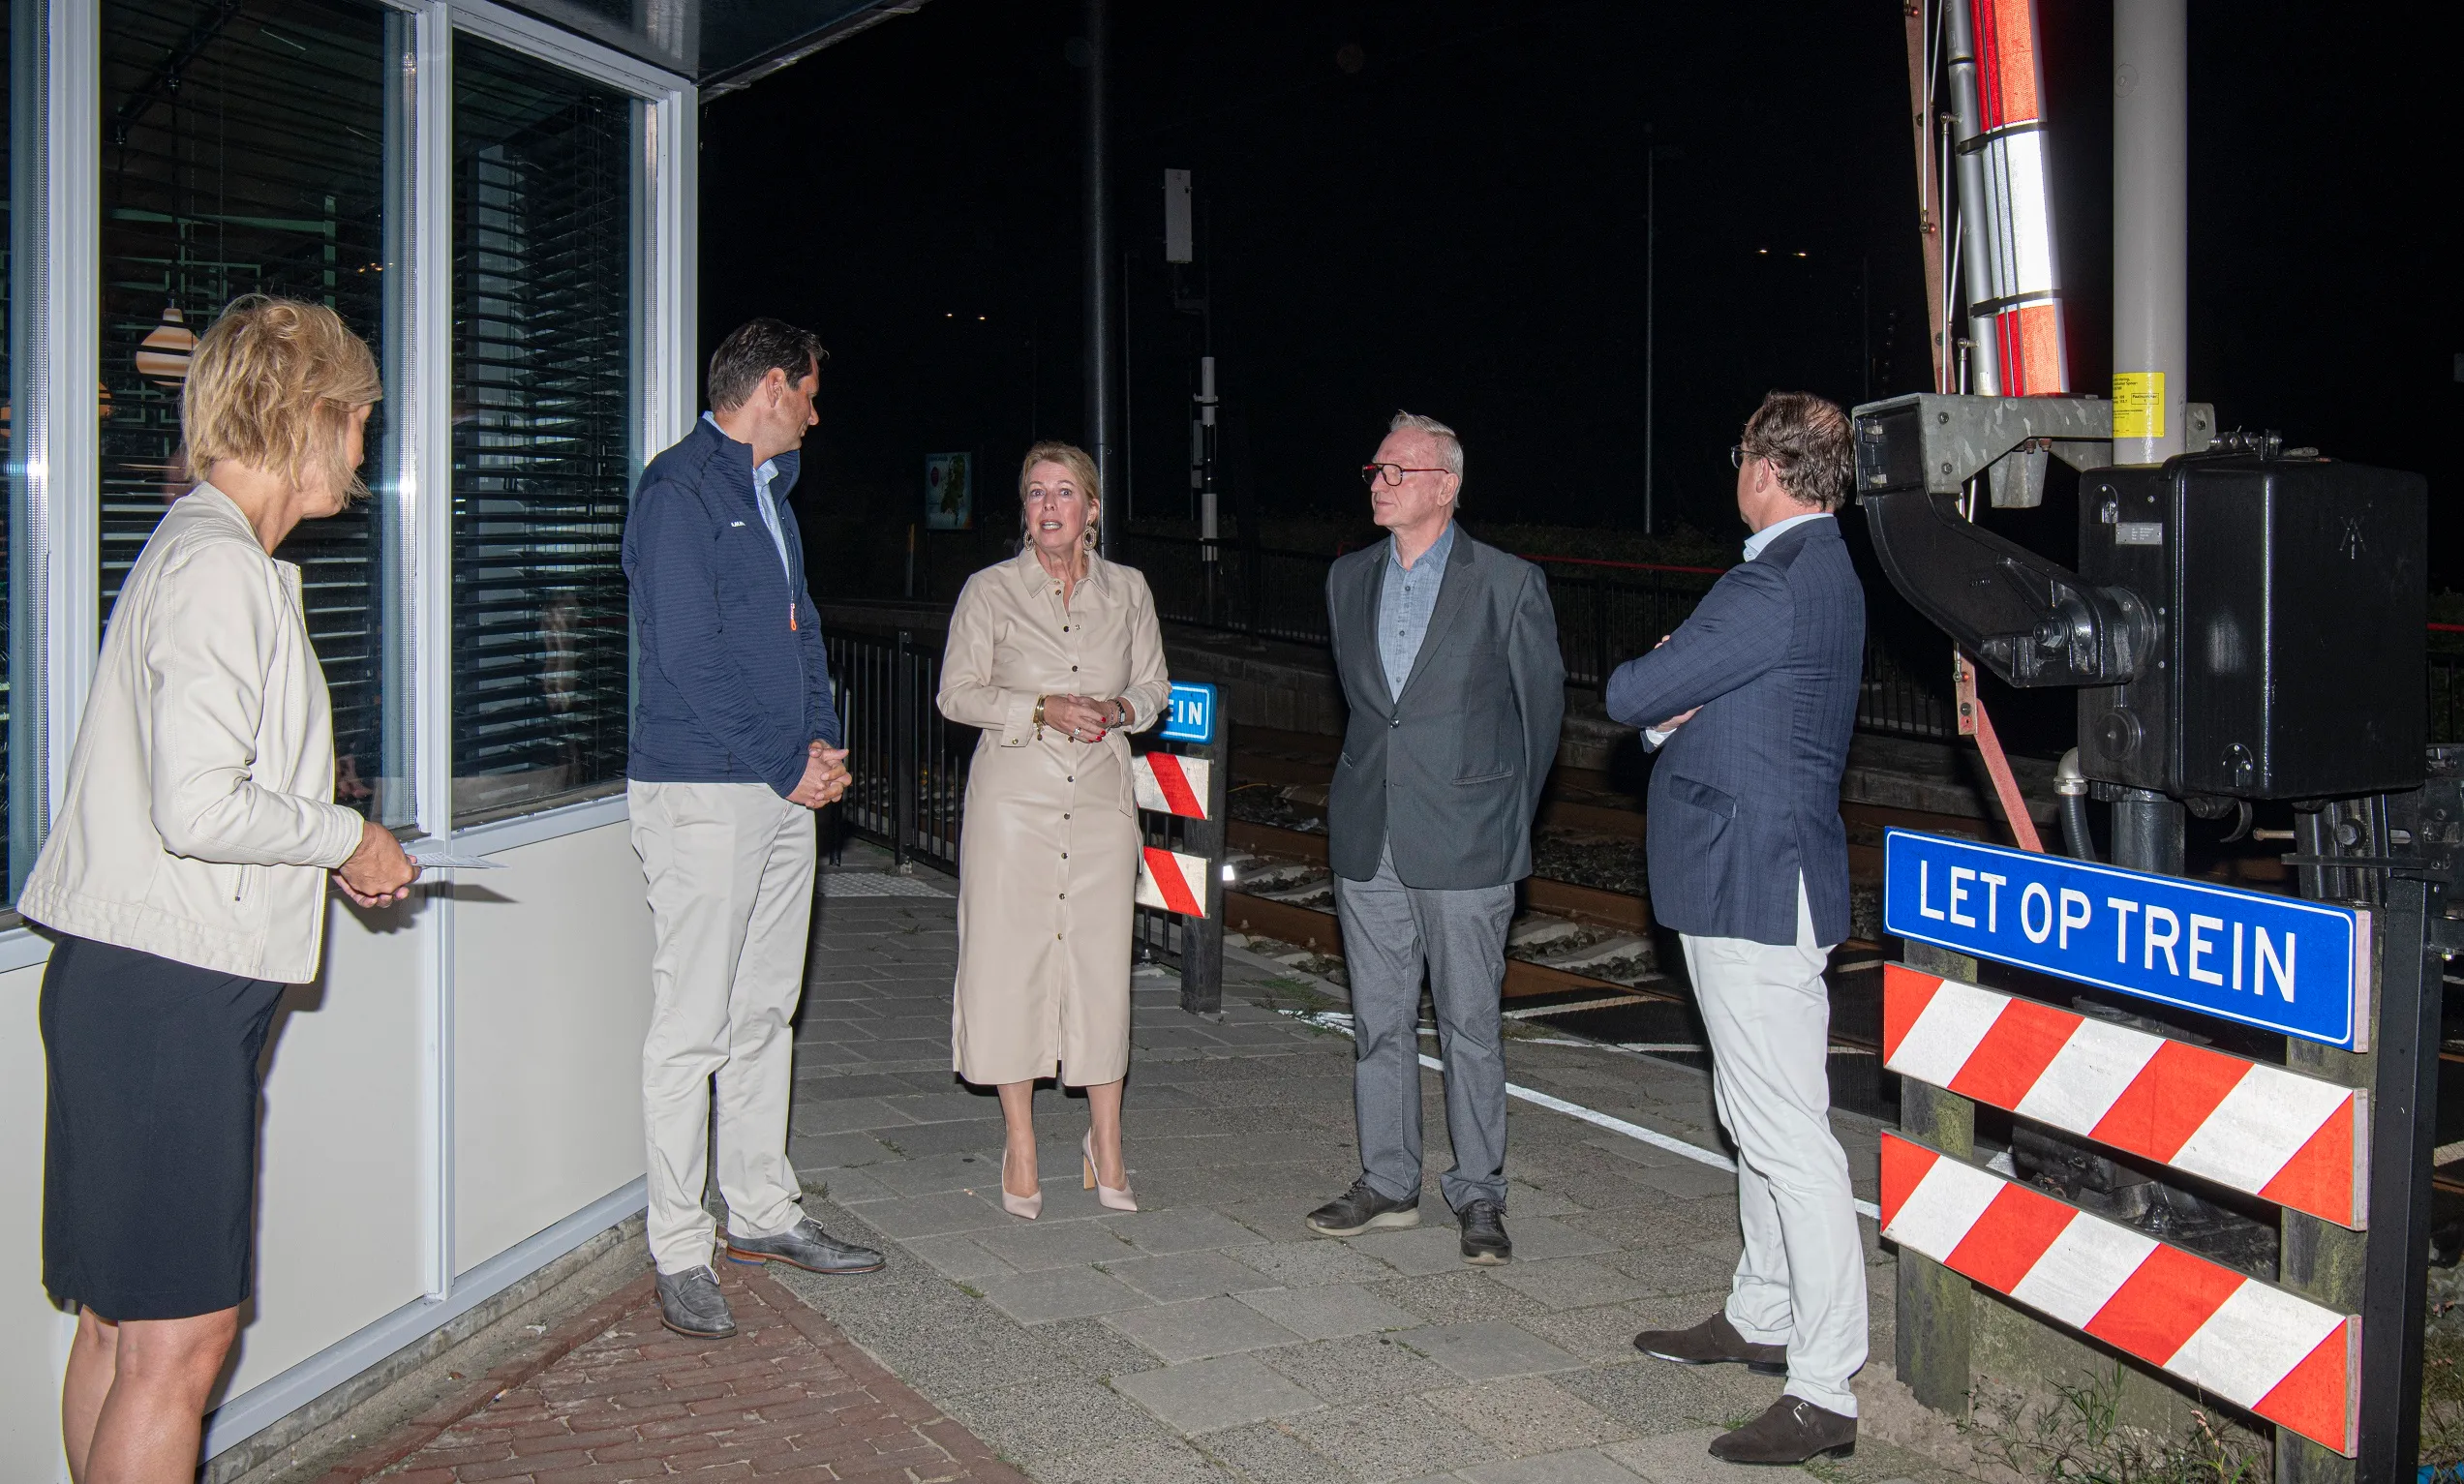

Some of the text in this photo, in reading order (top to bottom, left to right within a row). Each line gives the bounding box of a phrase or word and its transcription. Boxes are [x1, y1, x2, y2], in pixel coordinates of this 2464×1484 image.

[1920, 860, 2296, 1003] LET OP TREIN
